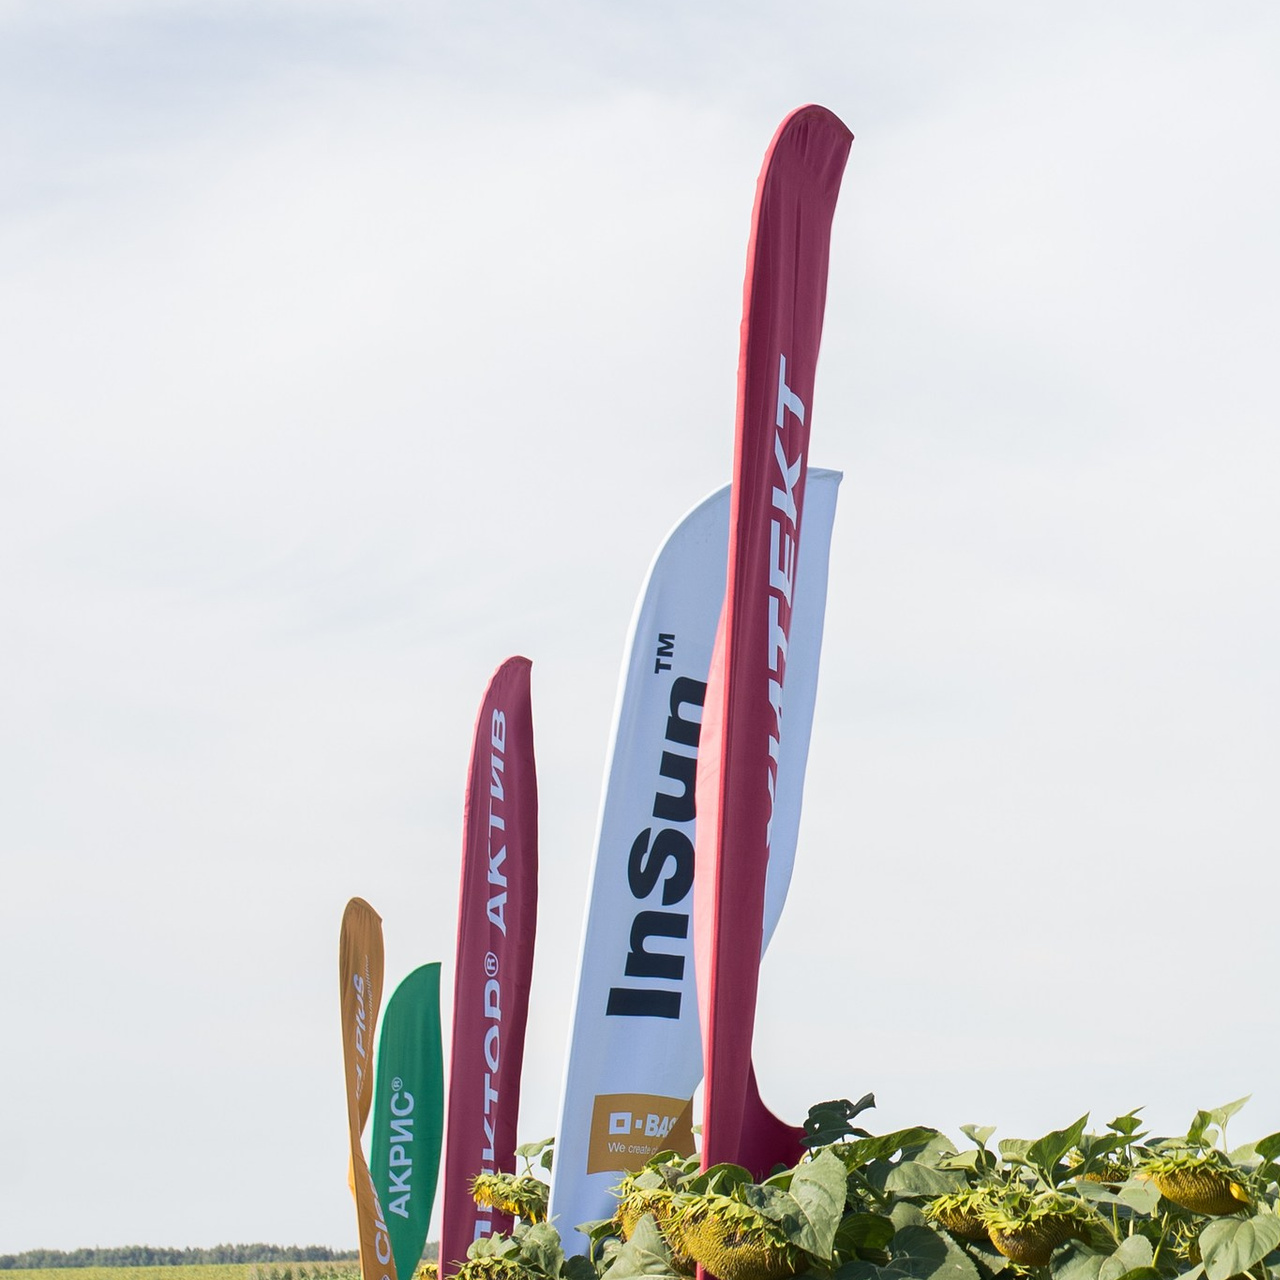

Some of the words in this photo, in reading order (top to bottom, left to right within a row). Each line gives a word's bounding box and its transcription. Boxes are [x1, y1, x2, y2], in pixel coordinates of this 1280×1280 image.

[487, 708, 508, 937] АКТИВ
[353, 973, 367, 1058] Plus
[608, 1142, 626, 1153] We
[628, 1144, 651, 1155] create
